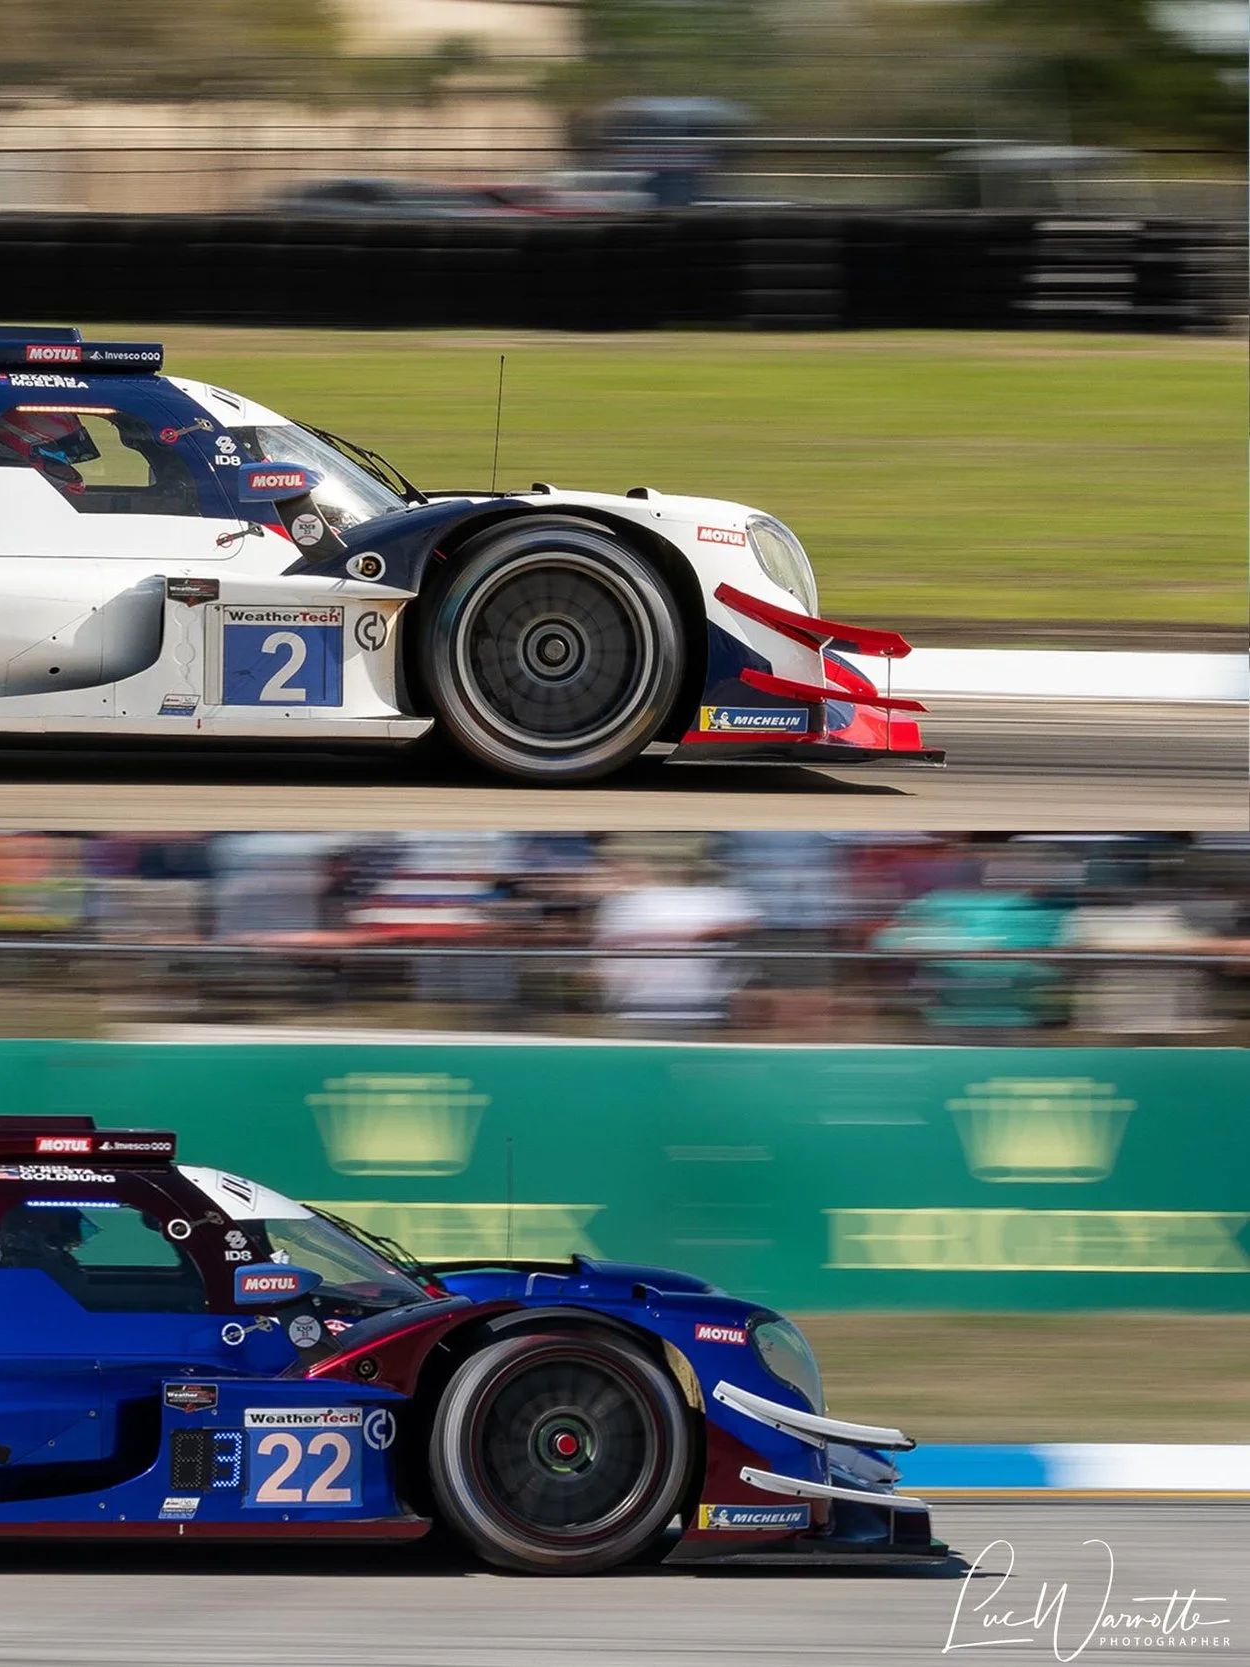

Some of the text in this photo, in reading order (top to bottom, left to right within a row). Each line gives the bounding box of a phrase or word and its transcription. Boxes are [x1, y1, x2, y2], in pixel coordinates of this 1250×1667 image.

[30, 348, 78, 360] MOTUL
[105, 352, 140, 360] Invesco
[215, 455, 241, 466] ID8
[252, 475, 303, 487] MOTUL
[700, 528, 745, 544] MOTUL
[230, 611, 340, 622] WeatherTech
[259, 631, 307, 701] 2
[733, 715, 800, 727] MICHELIN
[39, 1140, 90, 1151] MOTUL
[224, 1251, 252, 1261] ID8
[244, 1277, 296, 1290] MOTUL
[698, 1327, 745, 1343] MOTUL
[250, 1413, 360, 1424] WeatherTech
[213, 1432, 242, 1488] 3
[256, 1432, 351, 1502] 22
[732, 1512, 802, 1523] MICHELIN
